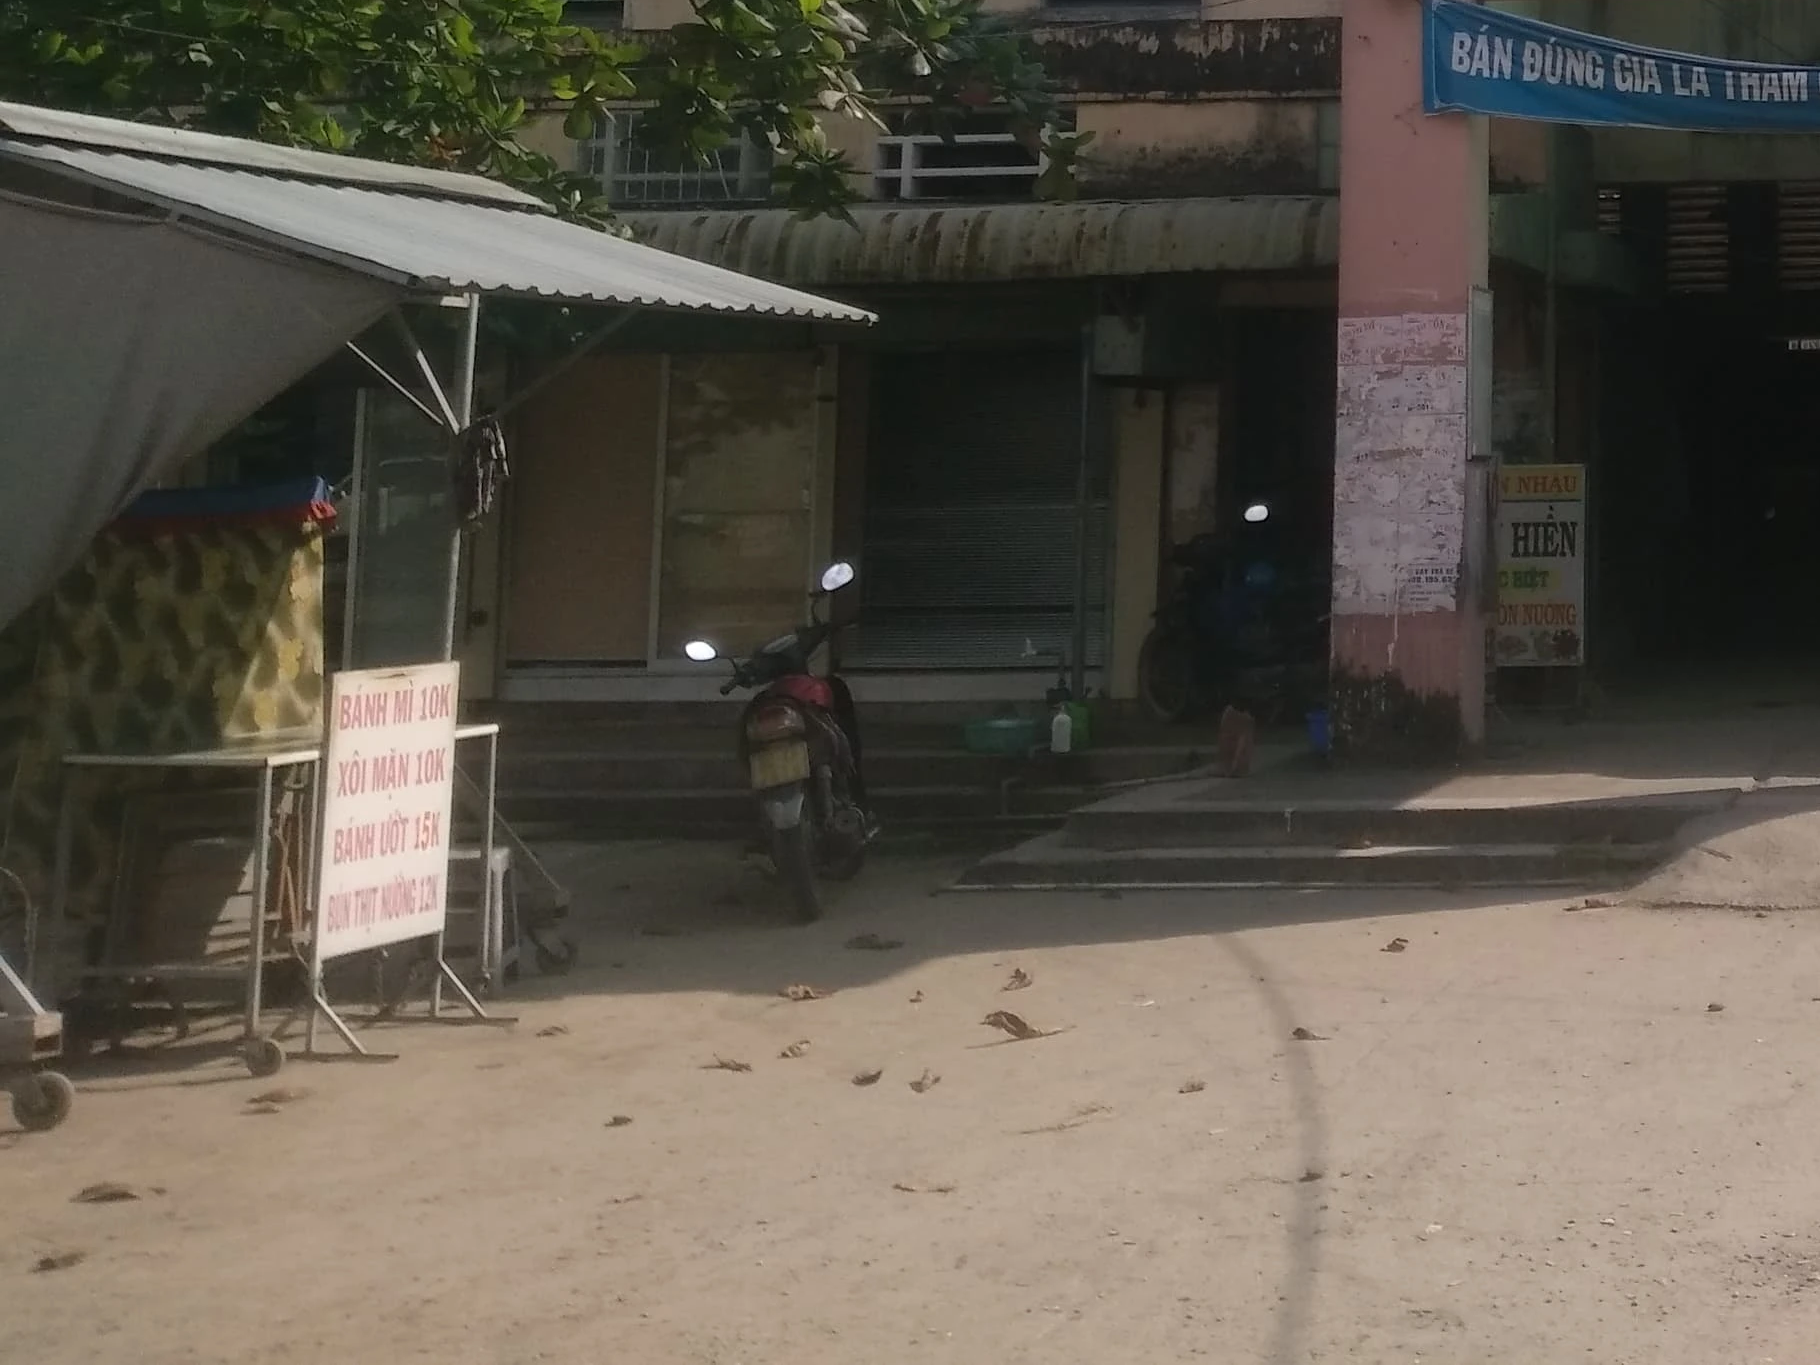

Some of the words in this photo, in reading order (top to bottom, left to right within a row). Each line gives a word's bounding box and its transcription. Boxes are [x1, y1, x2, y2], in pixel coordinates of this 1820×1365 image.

[1450, 23, 1513, 81] BÁN
[1521, 35, 1606, 91] ĐÚNG
[339, 684, 389, 731] BÁNH
[392, 681, 415, 725] MÌ
[418, 683, 452, 720] 10K
[336, 749, 367, 798] XÔI
[414, 746, 447, 786] 10K
[333, 816, 376, 866] BÁNH
[413, 810, 441, 852] 15K
